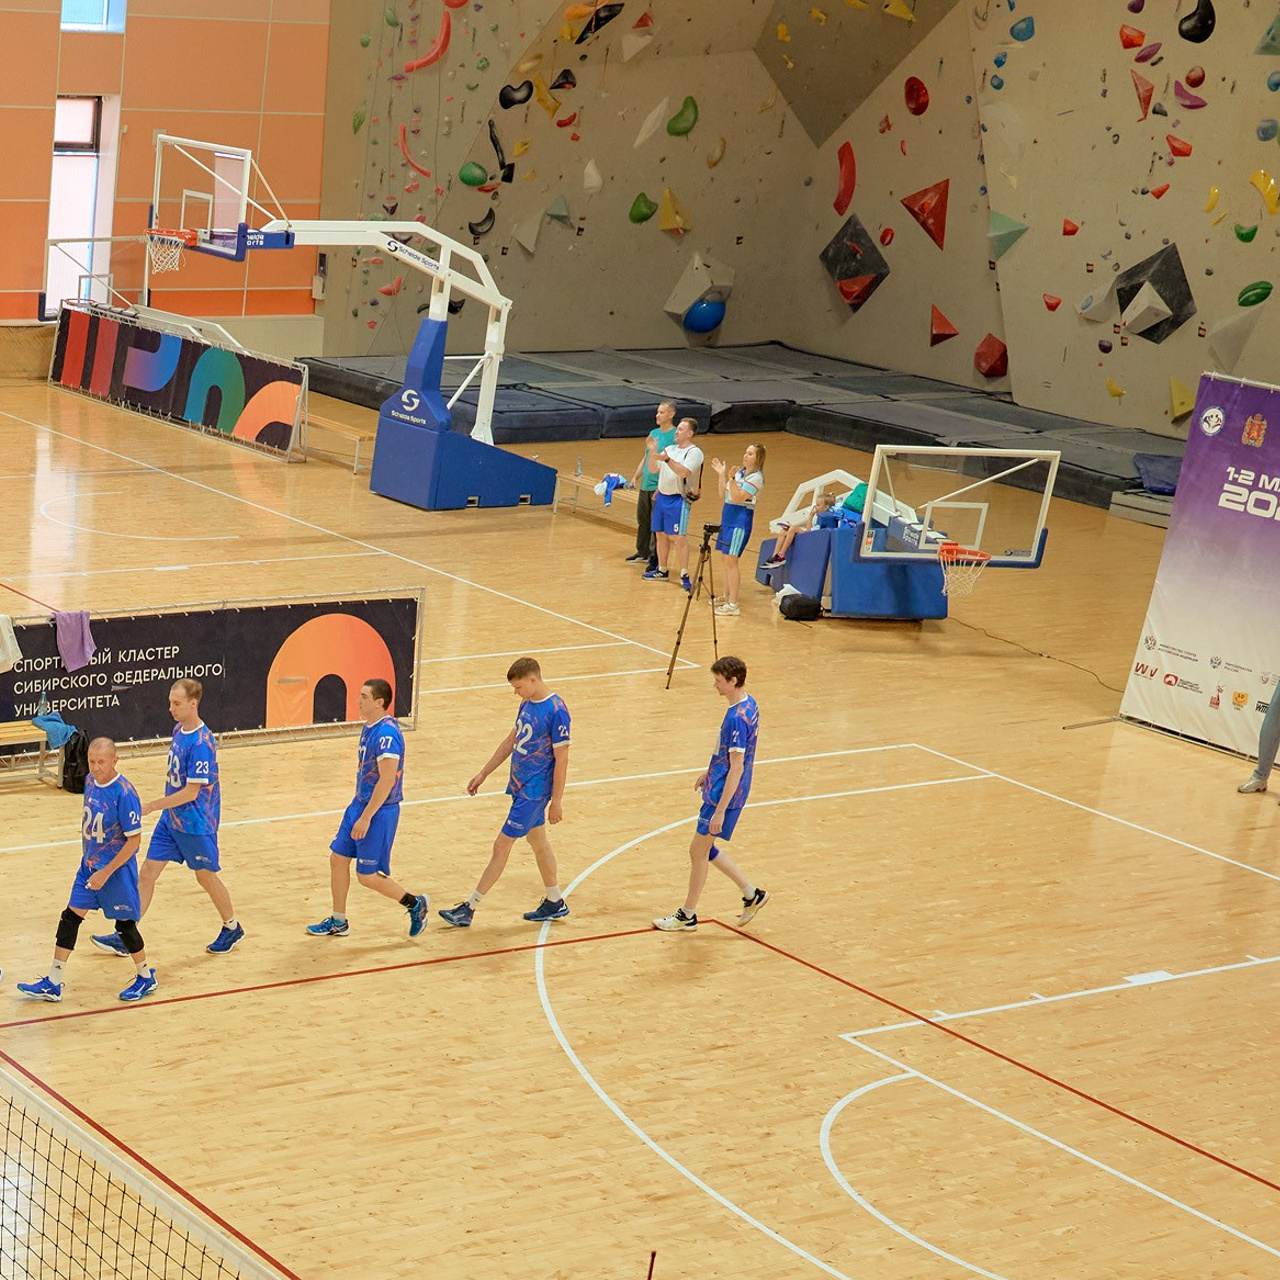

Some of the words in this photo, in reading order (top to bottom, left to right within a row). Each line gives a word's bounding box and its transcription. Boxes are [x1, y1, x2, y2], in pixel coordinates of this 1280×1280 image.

[1226, 466, 1255, 486] 1-2
[1258, 473, 1280, 493] М
[1218, 483, 1280, 521] 20
[673, 523, 679, 533] 5
[13, 648, 112, 674] СПОРТЫЙ
[118, 646, 180, 664] КЛАСТЕР
[13, 673, 107, 695] СИБИРСКОГО
[113, 663, 222, 685] ФЕДЕРАЛЬНОГО
[379, 736, 393, 749] 27
[195, 761, 209, 774] 23
[82, 805, 106, 844] 24
